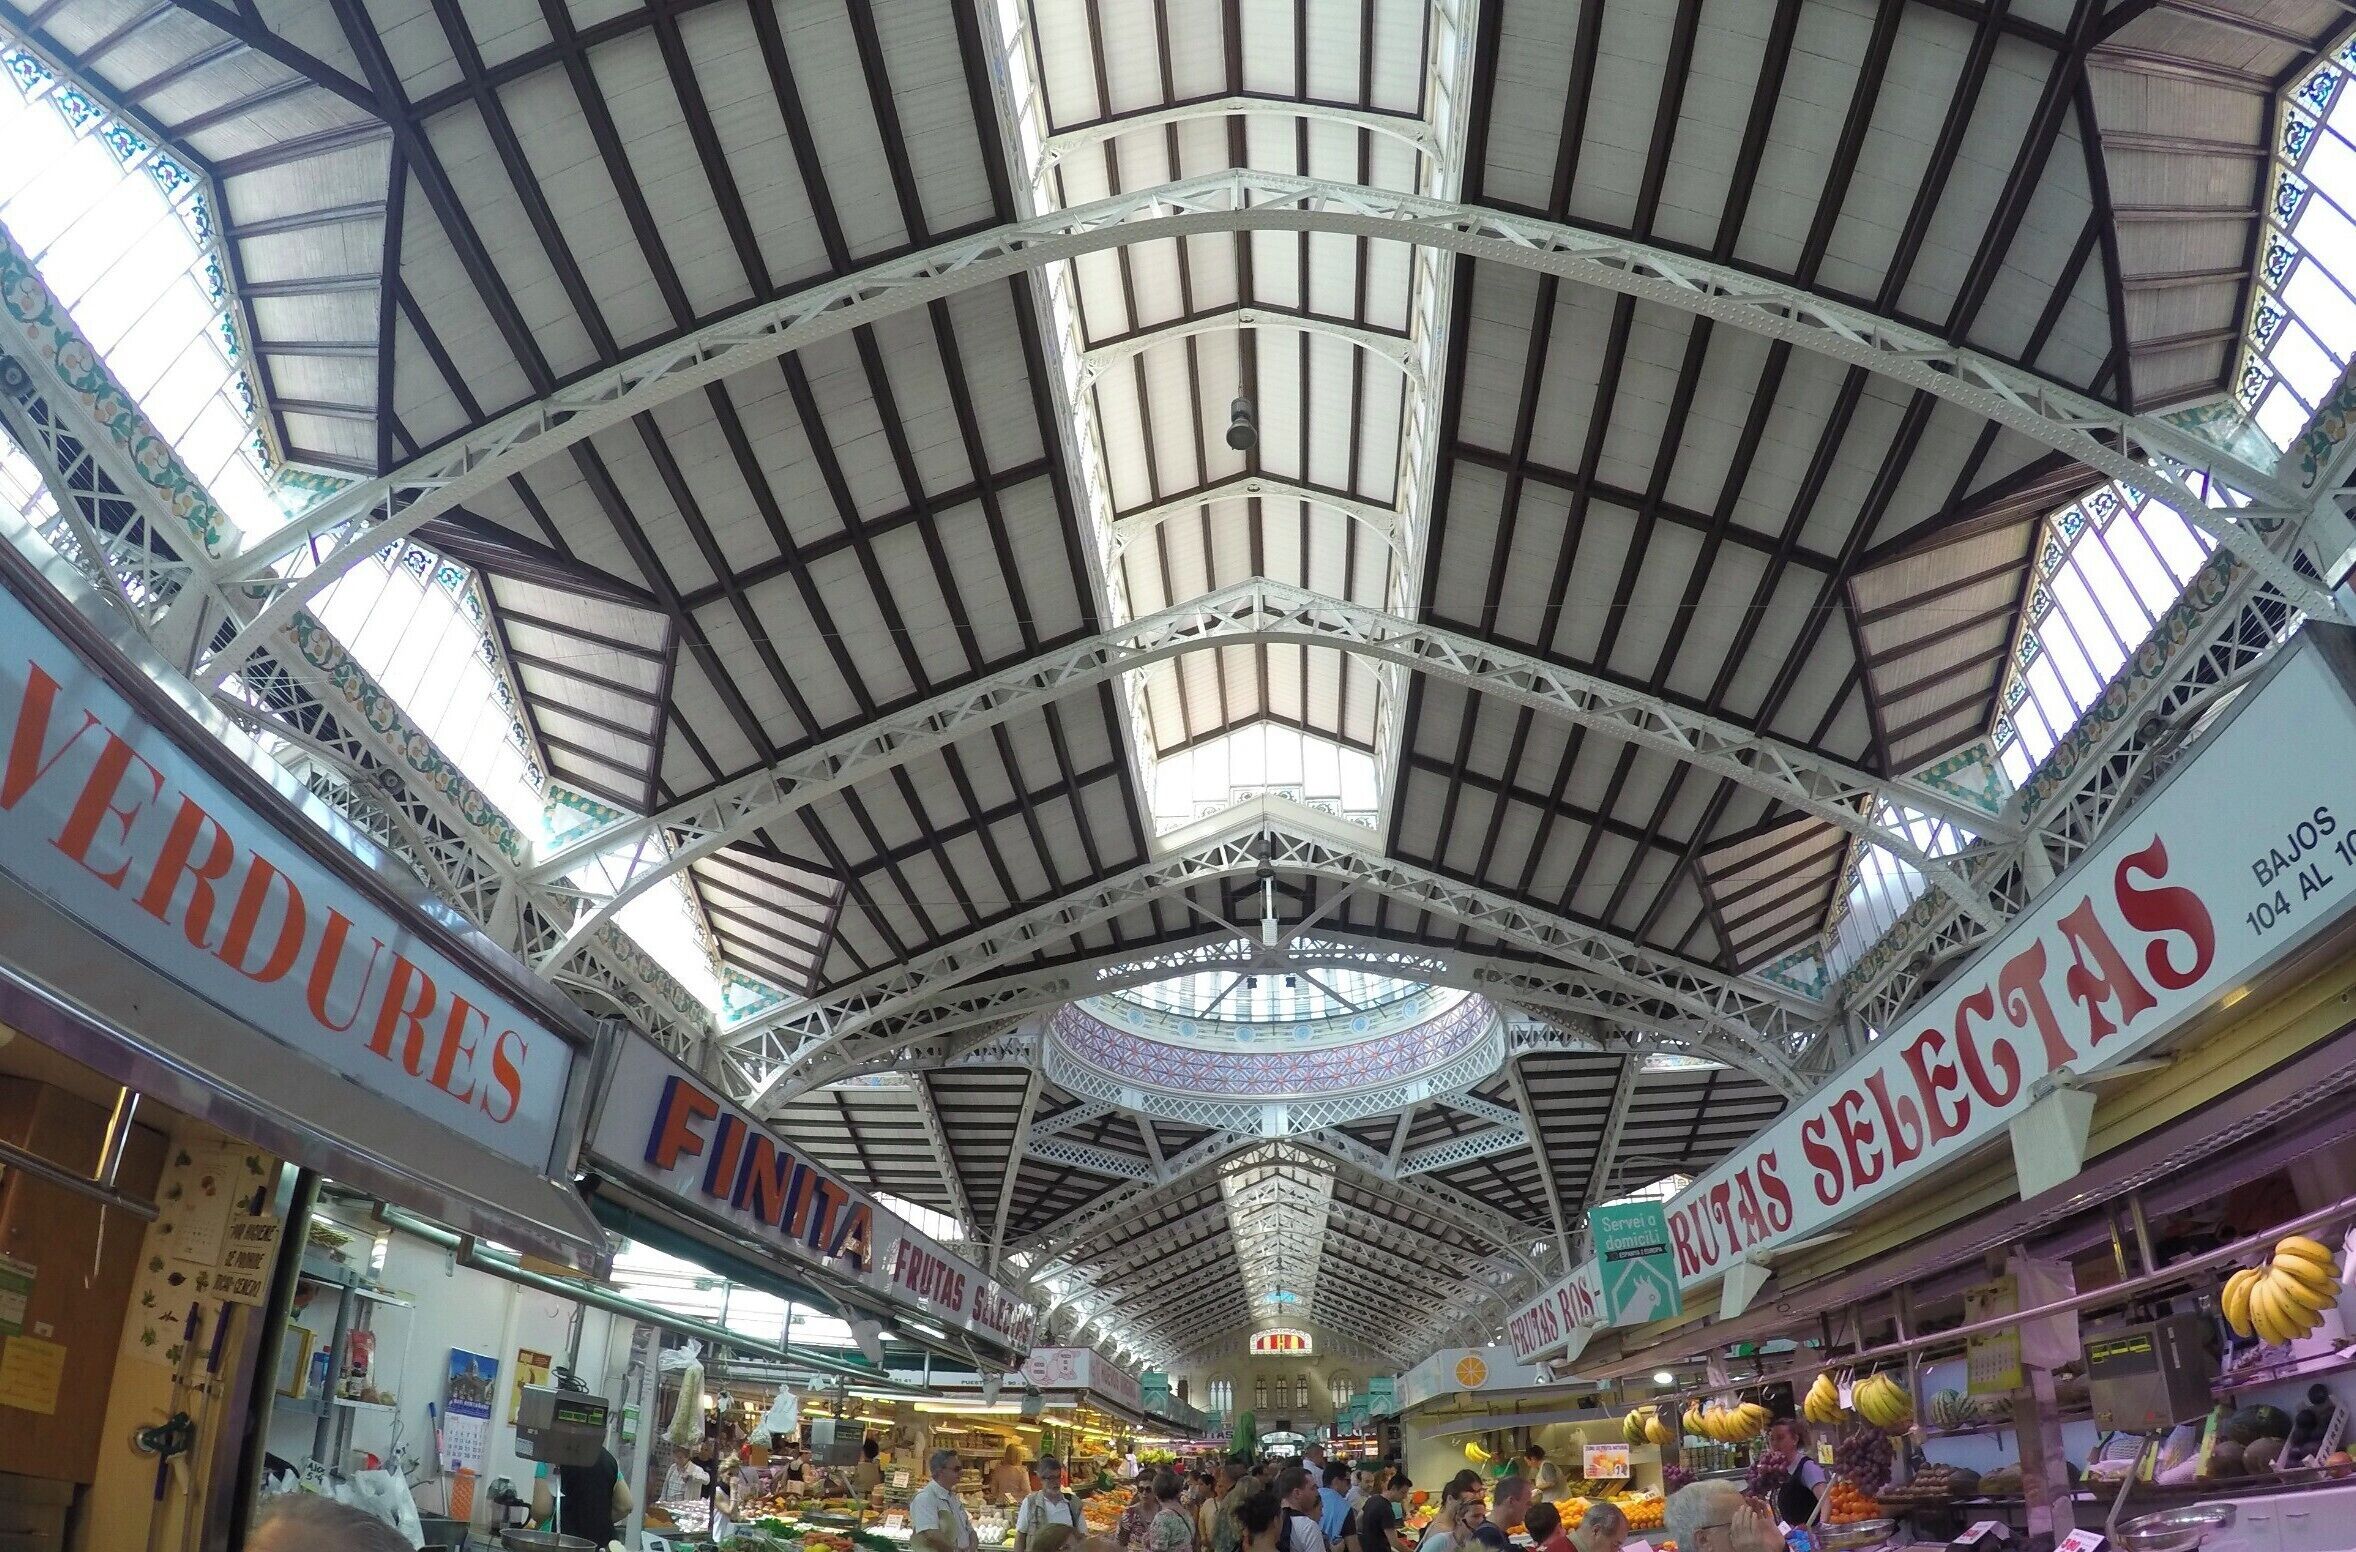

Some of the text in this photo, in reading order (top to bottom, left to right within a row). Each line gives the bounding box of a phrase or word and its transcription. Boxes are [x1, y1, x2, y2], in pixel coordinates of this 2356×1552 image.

[2251, 806, 2336, 887] BAJOS
[0, 658, 529, 1124] VERDURES
[2245, 889, 2291, 935] 104
[2298, 863, 2334, 901] AL
[1669, 833, 2216, 1278] RUTAS SELECTAS
[645, 1075, 874, 1273] FINITA
[1602, 1213, 1644, 1232] Servei
[1605, 1230, 1660, 1250] domicili
[893, 1237, 966, 1312] FRUTAS
[1509, 1298, 1559, 1359] FRUTAS
